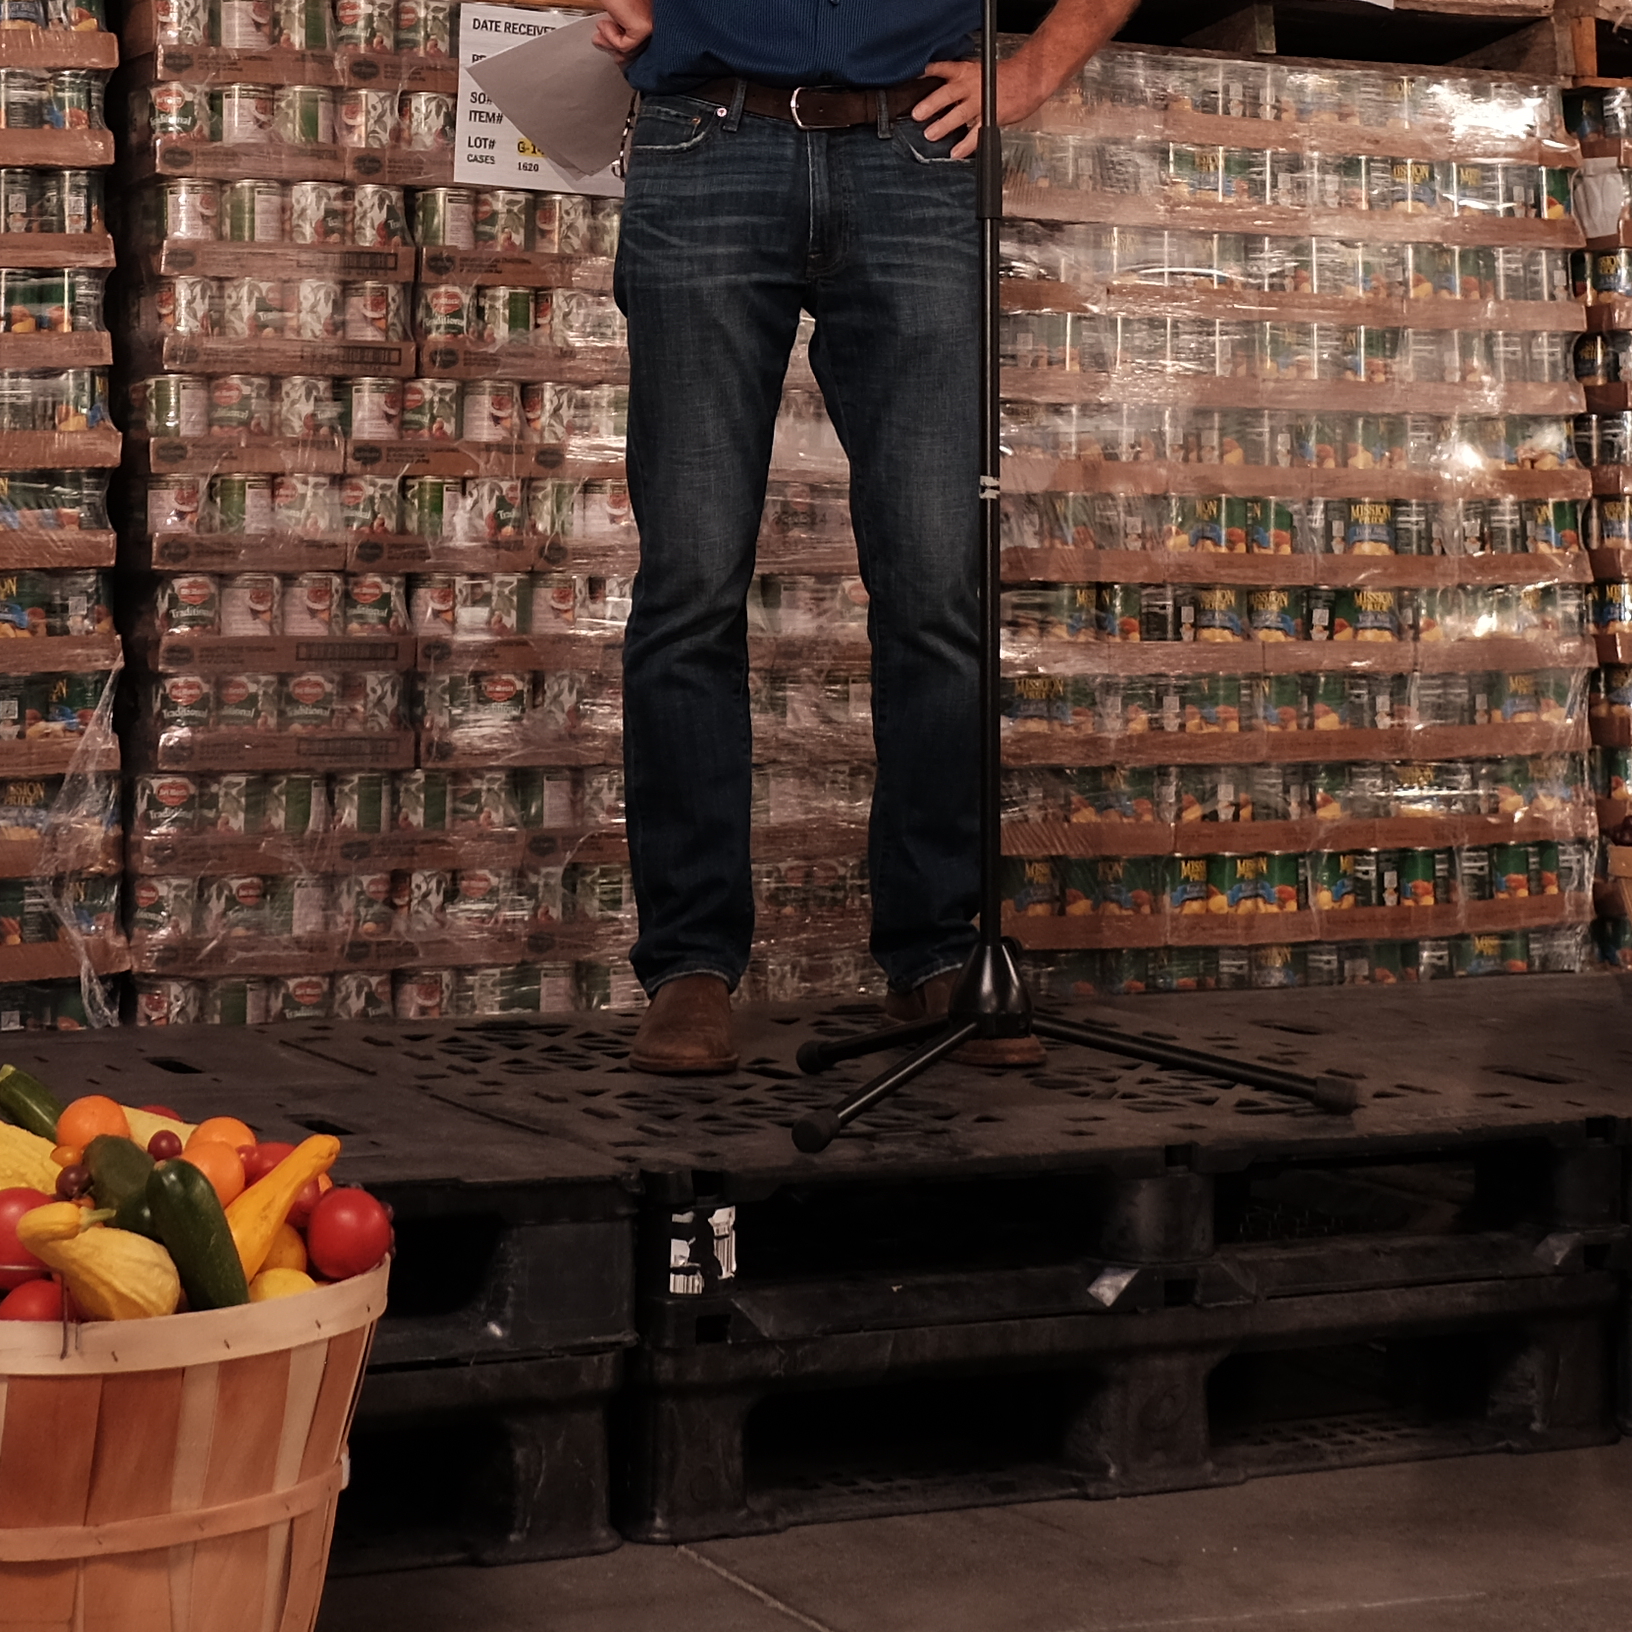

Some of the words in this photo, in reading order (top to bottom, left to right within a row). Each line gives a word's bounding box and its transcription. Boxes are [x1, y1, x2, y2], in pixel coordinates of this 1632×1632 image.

[473, 18, 501, 33] DATE
[469, 110, 503, 124] ITEM#
[468, 136, 496, 150] LOT#
[467, 154, 495, 165] CASES
[518, 162, 539, 172] 1620
[1350, 503, 1392, 518] MISSION
[1354, 590, 1395, 605] MISSION
[170, 606, 214, 618] Traditional
